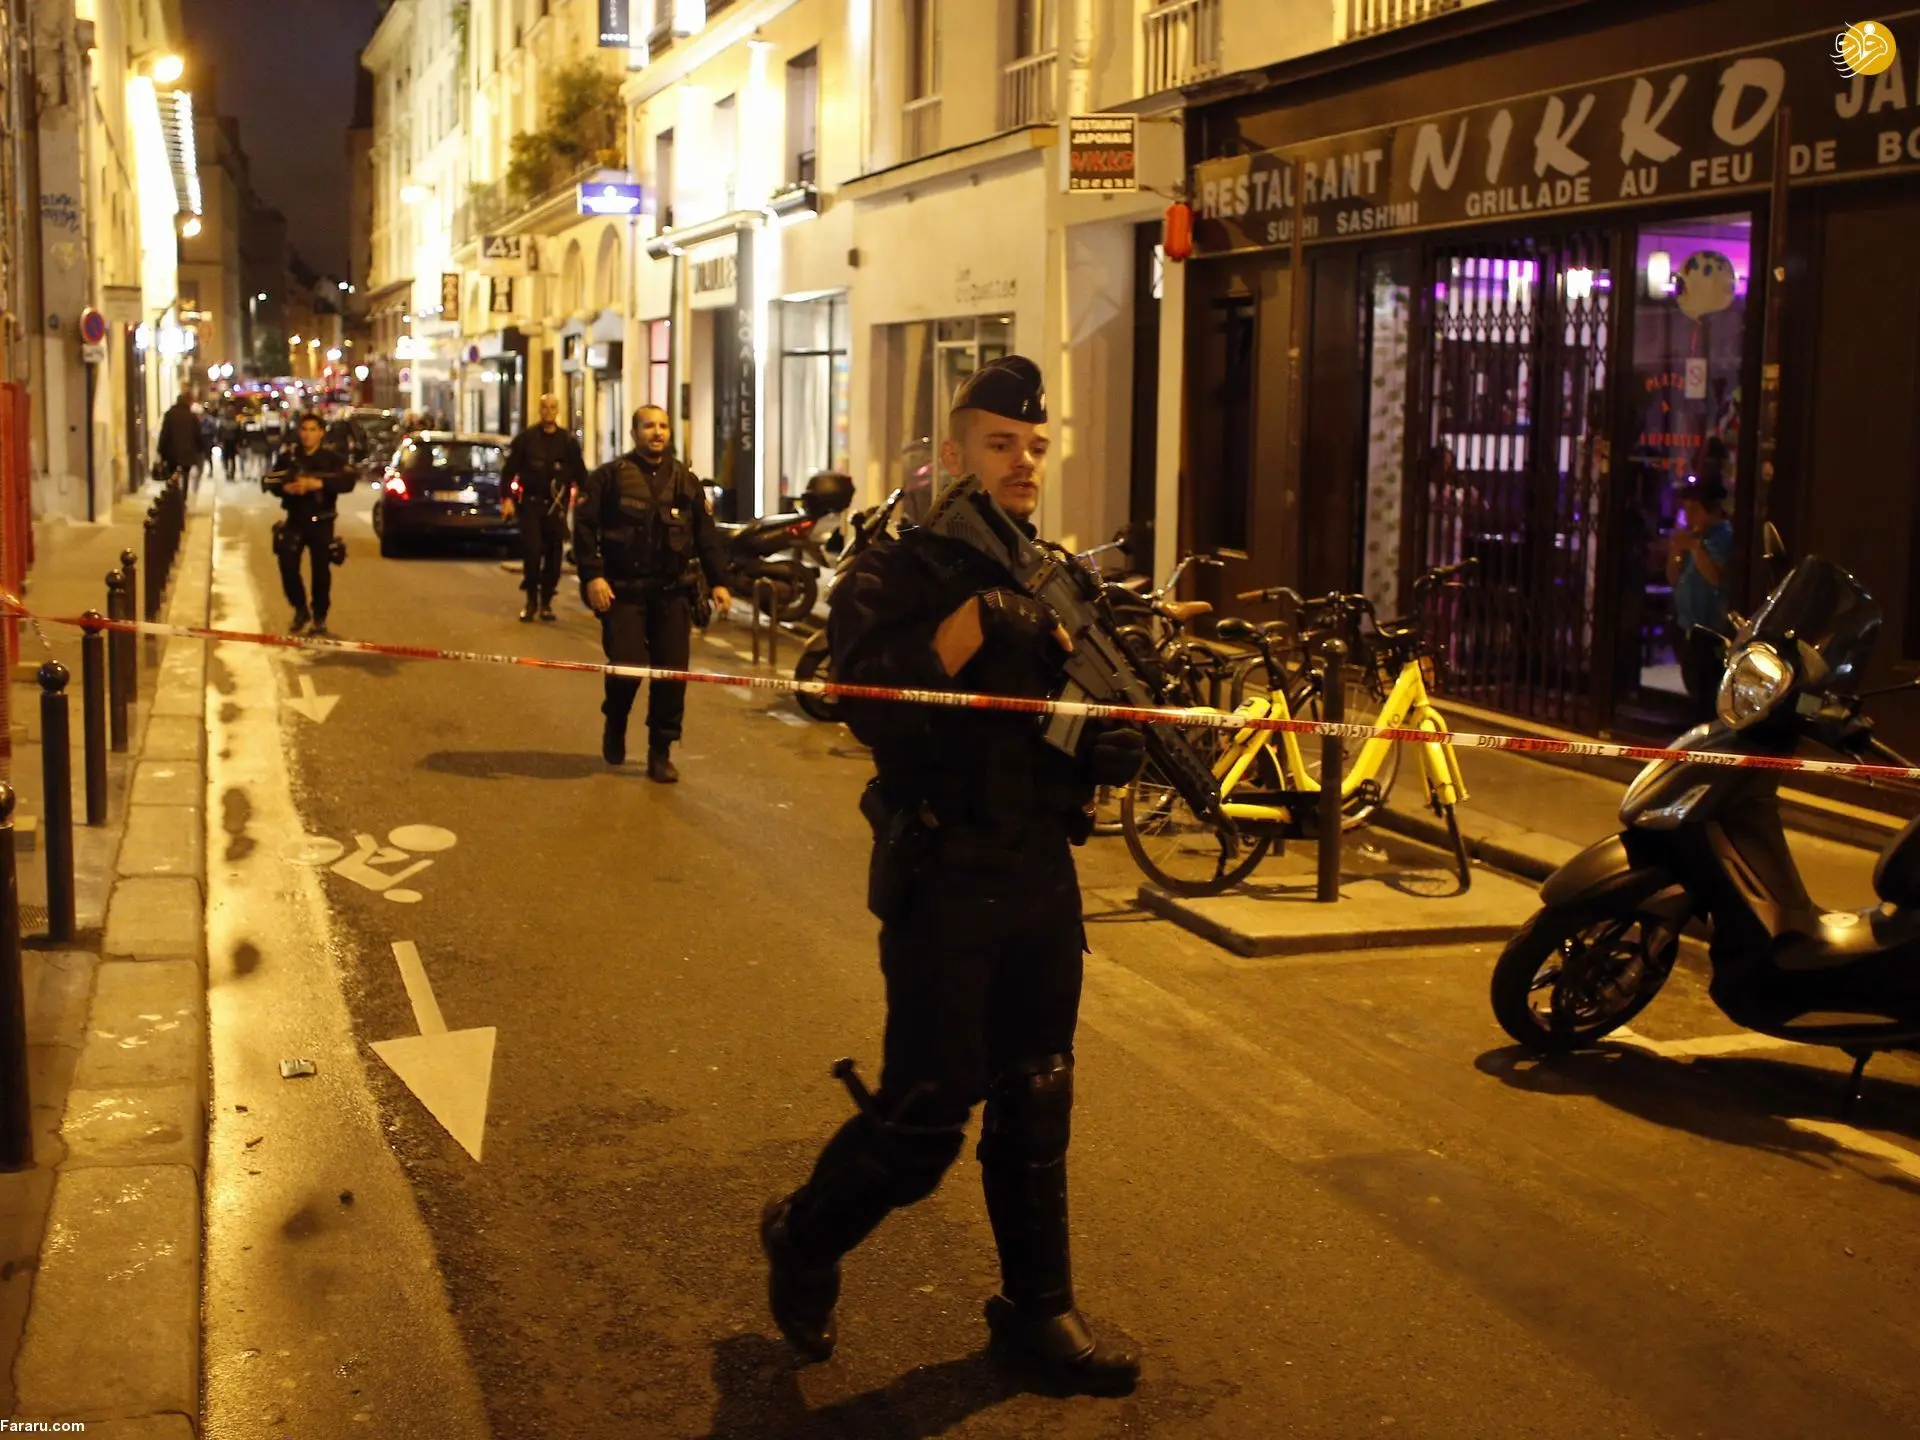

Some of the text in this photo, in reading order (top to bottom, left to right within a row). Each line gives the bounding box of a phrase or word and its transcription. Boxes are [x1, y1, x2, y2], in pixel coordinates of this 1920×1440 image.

[1071, 149, 1134, 173] NIKKO
[1072, 132, 1132, 145] JAPONAIS
[1409, 57, 1785, 194] NIKKO
[1835, 46, 1920, 119] JA
[1336, 201, 1419, 234] SASHIMI
[1465, 178, 1591, 217] GRILLADE
[1619, 167, 1658, 197] AU
[1690, 153, 1753, 189] FEU
[1789, 140, 1837, 175] DE
[738, 308, 753, 451] NOAILLES
